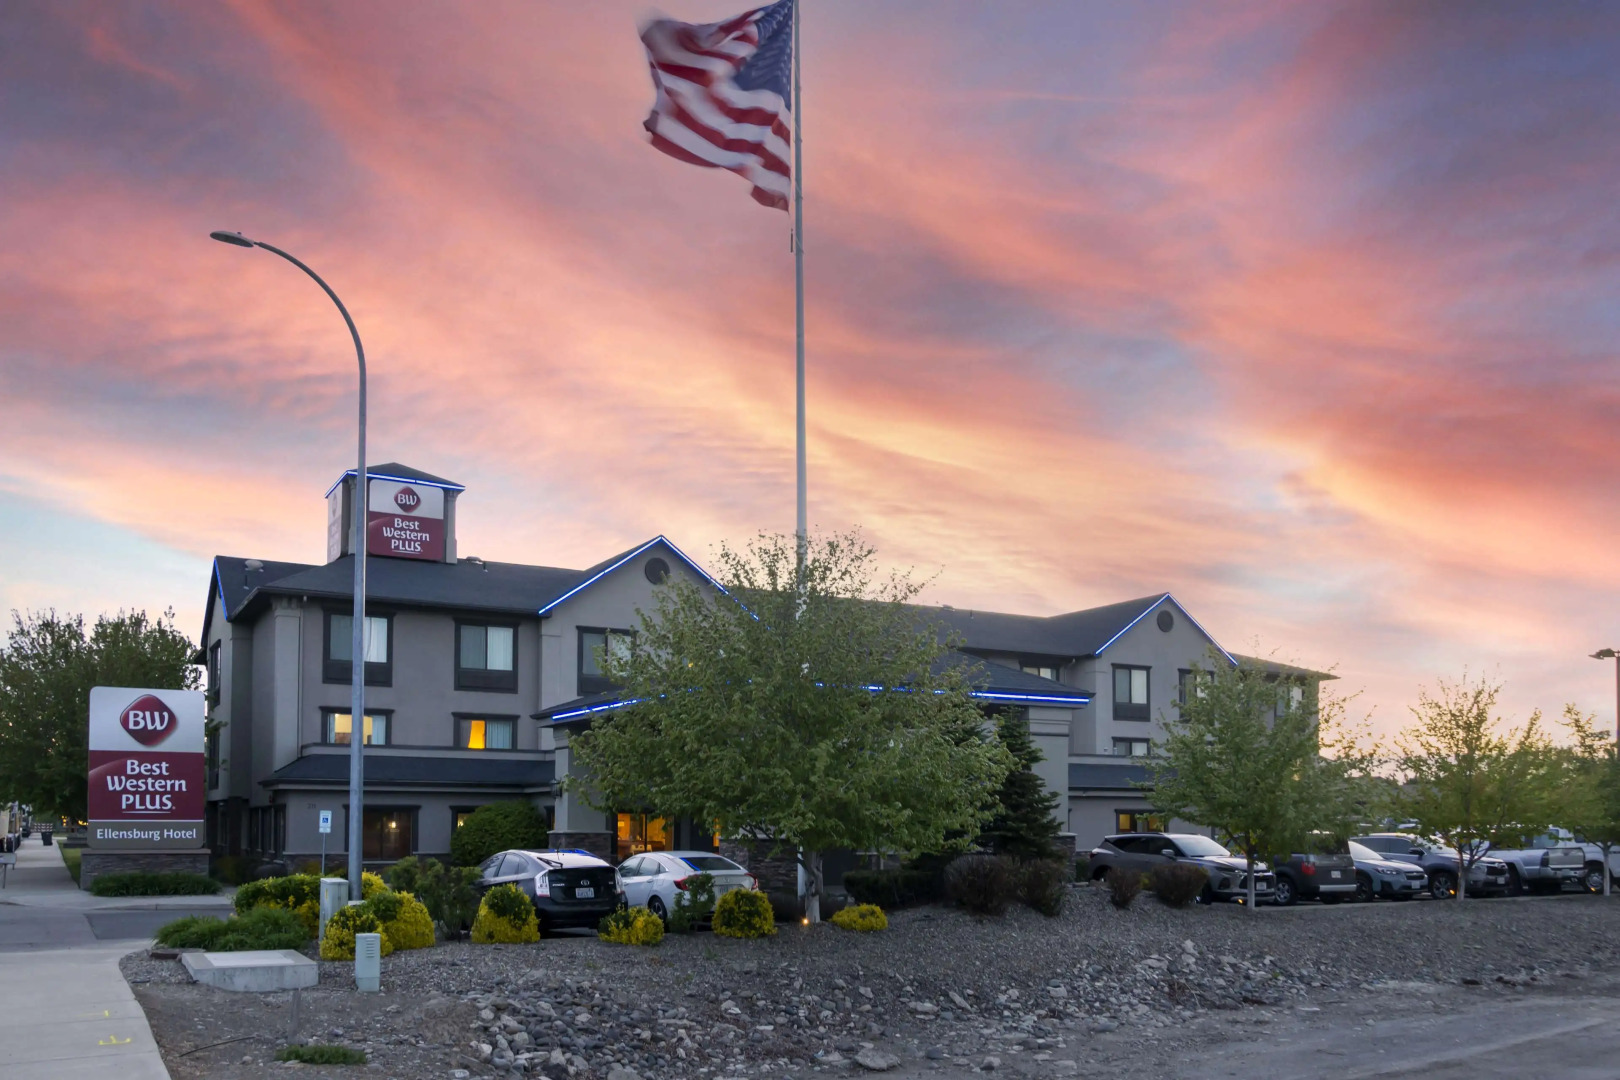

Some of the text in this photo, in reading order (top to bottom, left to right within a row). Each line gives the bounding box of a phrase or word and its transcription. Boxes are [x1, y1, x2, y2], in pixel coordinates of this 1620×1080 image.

[397, 494, 417, 506] BW
[394, 518, 420, 530] Best
[382, 526, 430, 541] Western
[391, 540, 421, 552] PLUS
[128, 710, 169, 731] BW
[126, 759, 170, 775] Best
[106, 775, 187, 792] Western
[121, 794, 172, 810] PLUS
[96, 828, 197, 841] Ellensburg Hotel
